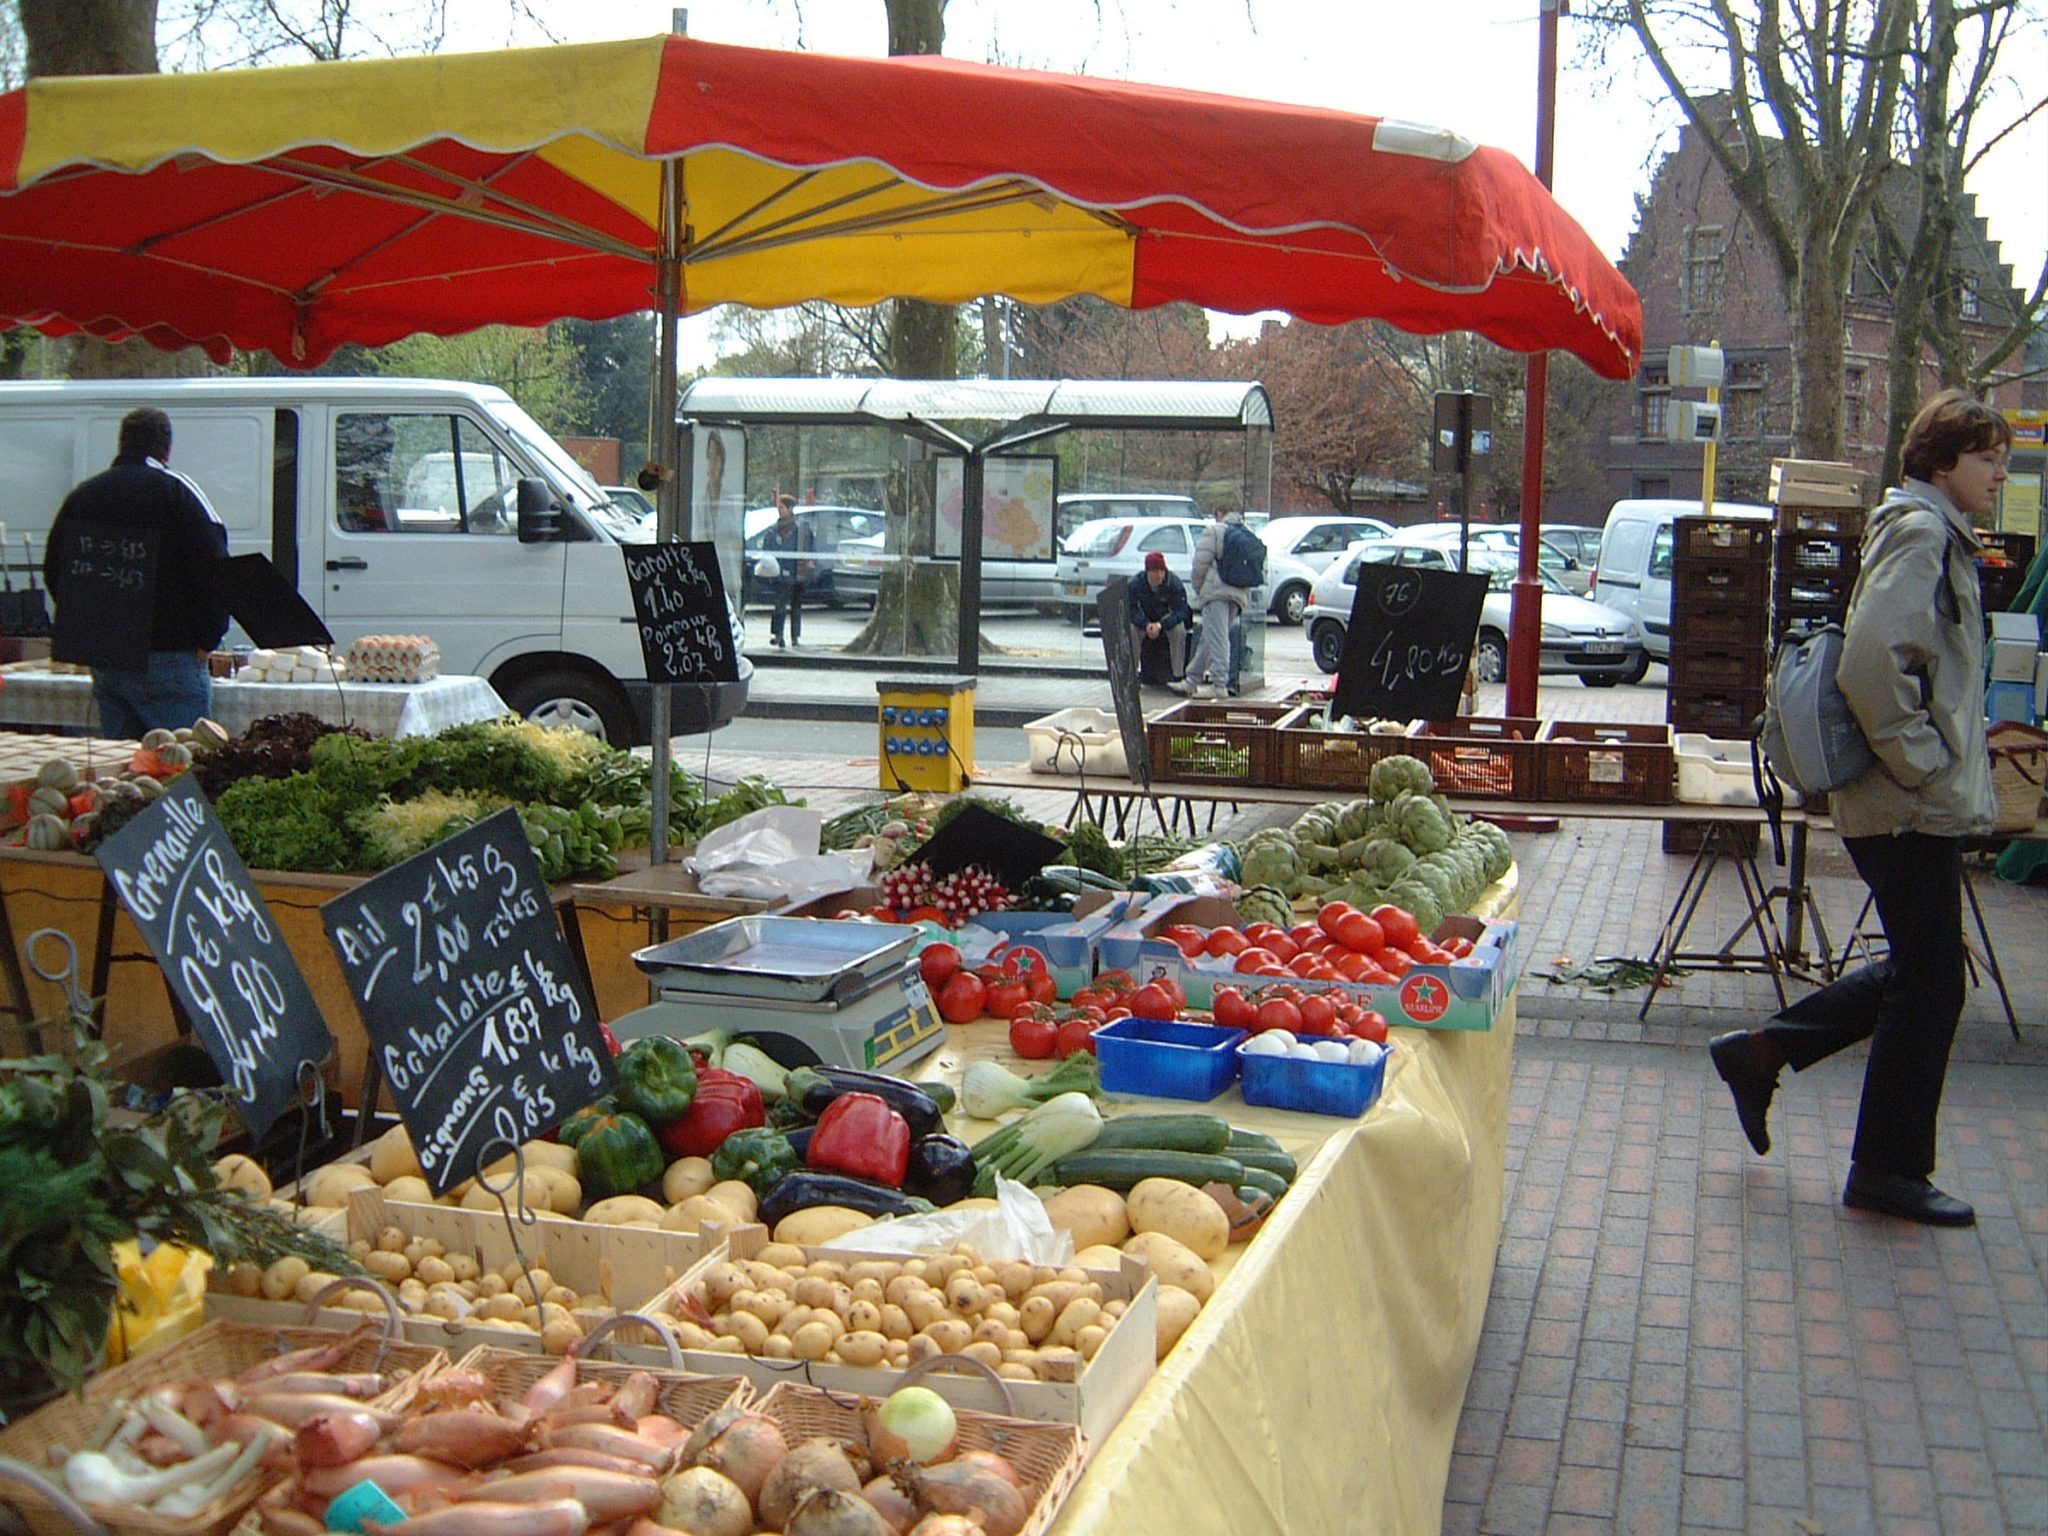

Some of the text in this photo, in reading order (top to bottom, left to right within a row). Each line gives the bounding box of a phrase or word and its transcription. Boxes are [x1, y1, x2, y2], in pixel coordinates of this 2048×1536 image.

[627, 546, 692, 582] Carotte
[642, 614, 709, 650] Poireaux
[114, 796, 205, 921] Grenaille
[335, 903, 387, 966] Ail
[421, 1065, 492, 1170] oignons
